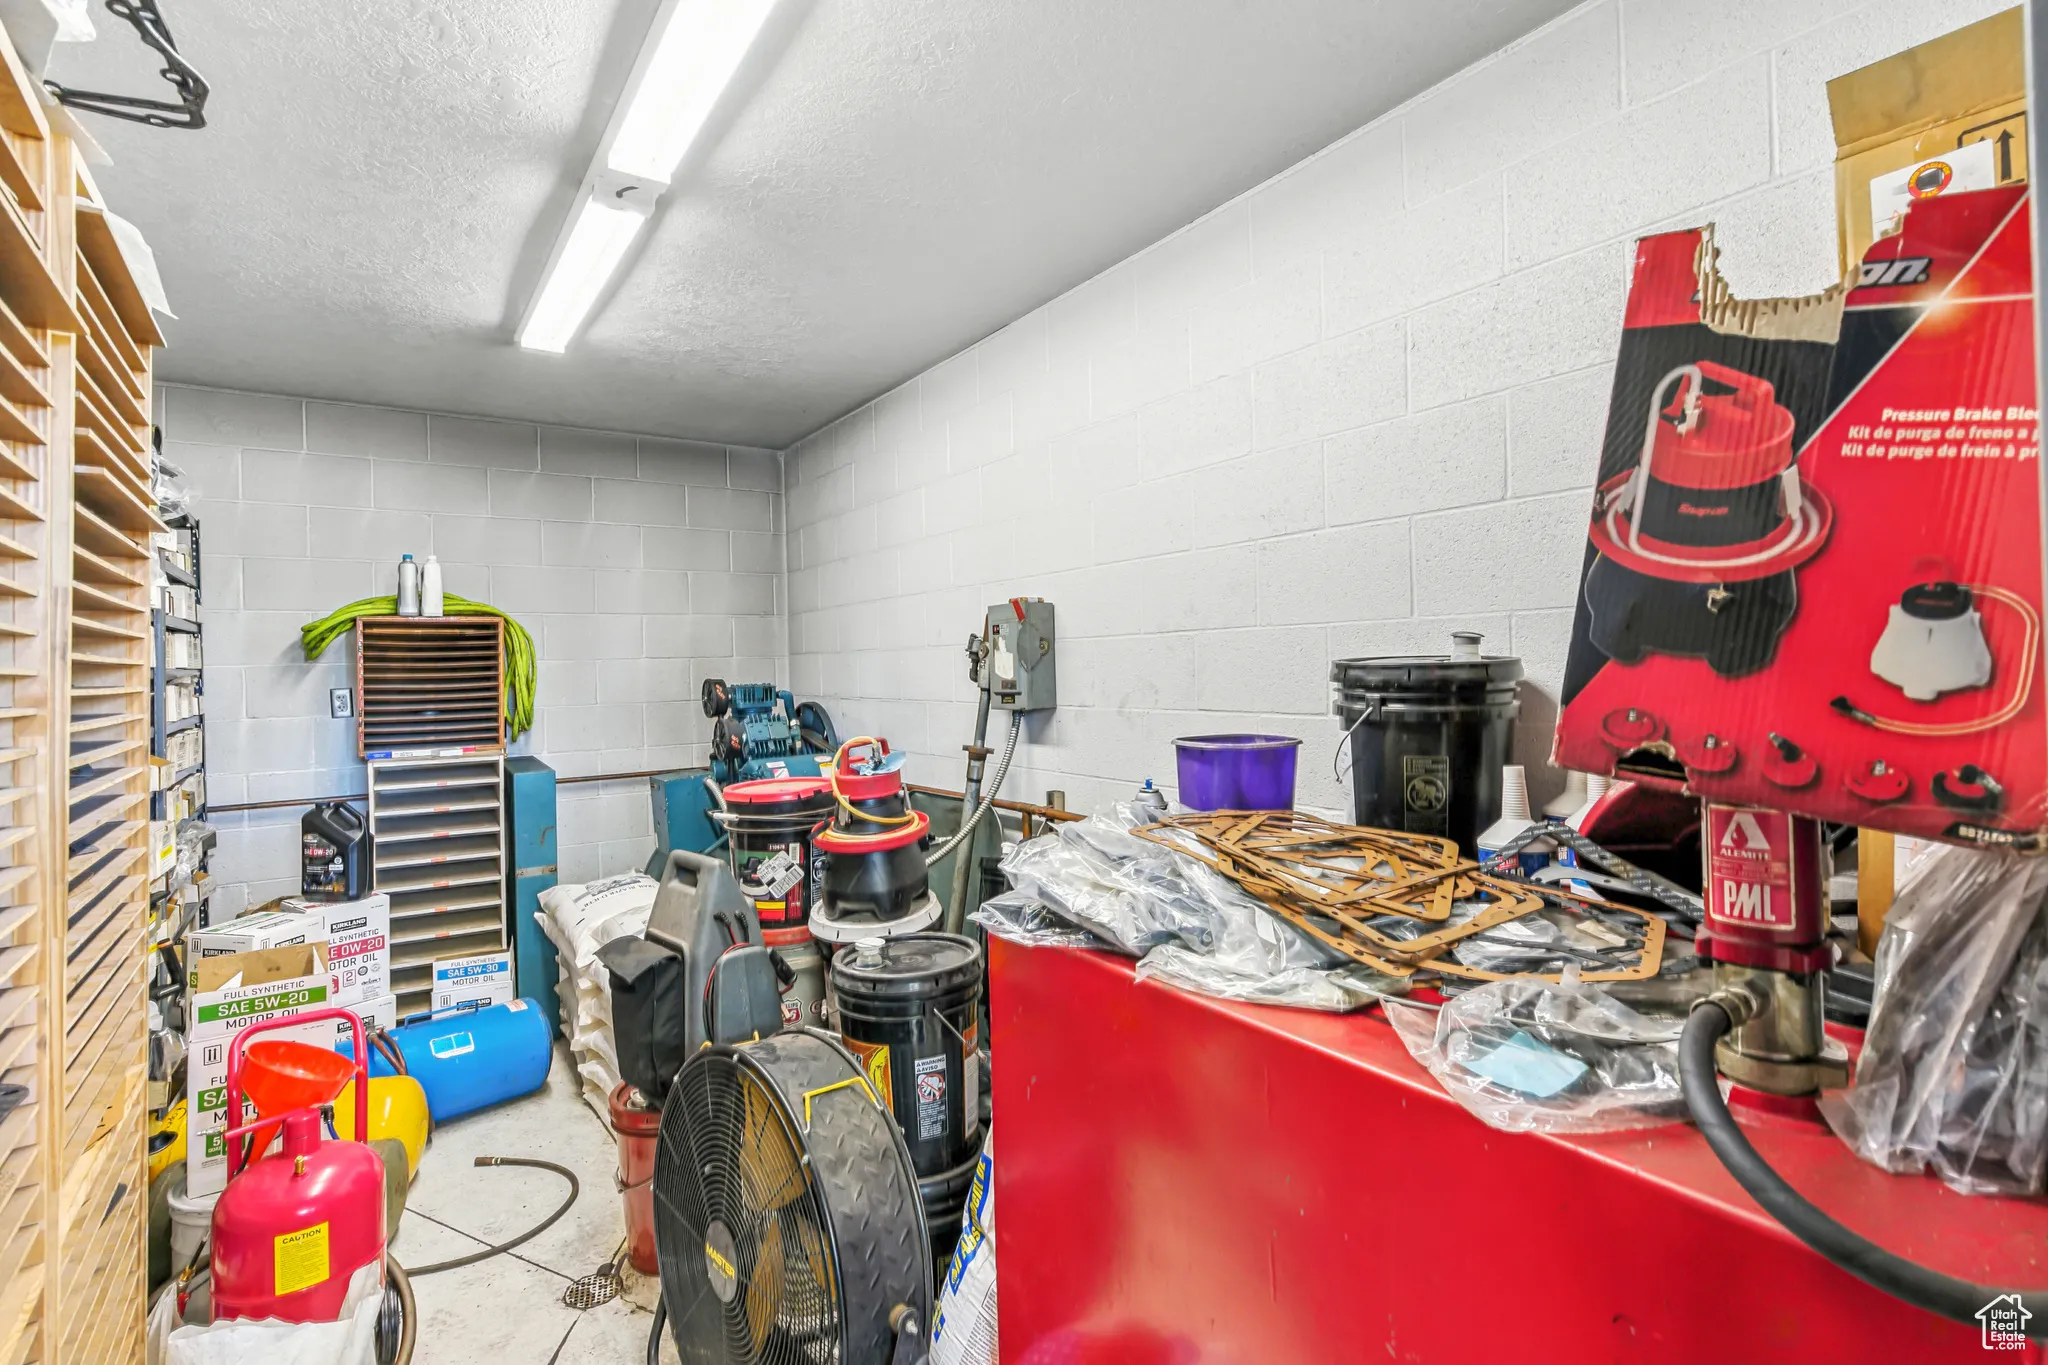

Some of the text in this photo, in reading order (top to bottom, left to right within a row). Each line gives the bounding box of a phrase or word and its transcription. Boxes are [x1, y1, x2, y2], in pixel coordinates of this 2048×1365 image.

[1882, 407, 1950, 422] Pressure
[1953, 407, 2002, 421] Brake
[1848, 426, 1870, 439] Kit
[1873, 427, 1893, 439] de
[1895, 428, 1941, 442] purga
[1945, 427, 1965, 439] de
[1968, 425, 2013, 439] freno
[2017, 428, 2028, 439] a
[1841, 444, 1863, 457] Kit
[1866, 444, 1885, 457] de
[1888, 446, 1934, 460] purge
[1937, 444, 1957, 457] de
[1960, 443, 2000, 458] frein
[1723, 880, 1776, 921] PML
[332, 918, 366, 930] KIRKLAND
[338, 928, 379, 943] SYNTHETIC
[329, 952, 378, 971] OTOR OIL
[466, 957, 496, 966] SYNTHETIC
[345, 971, 353, 982] 2
[448, 964, 499, 977] SAE 5W-30
[452, 974, 496, 986] MOTOR OIL
[224, 980, 305, 1000] FULL SYNTHETIC
[218, 991, 309, 1017] SAE 5W-20
[921, 1057, 946, 1066] WARNING
[921, 1065, 939, 1073] AVISO
[203, 1087, 228, 1107] SA
[282, 1228, 322, 1244] CAUTION
